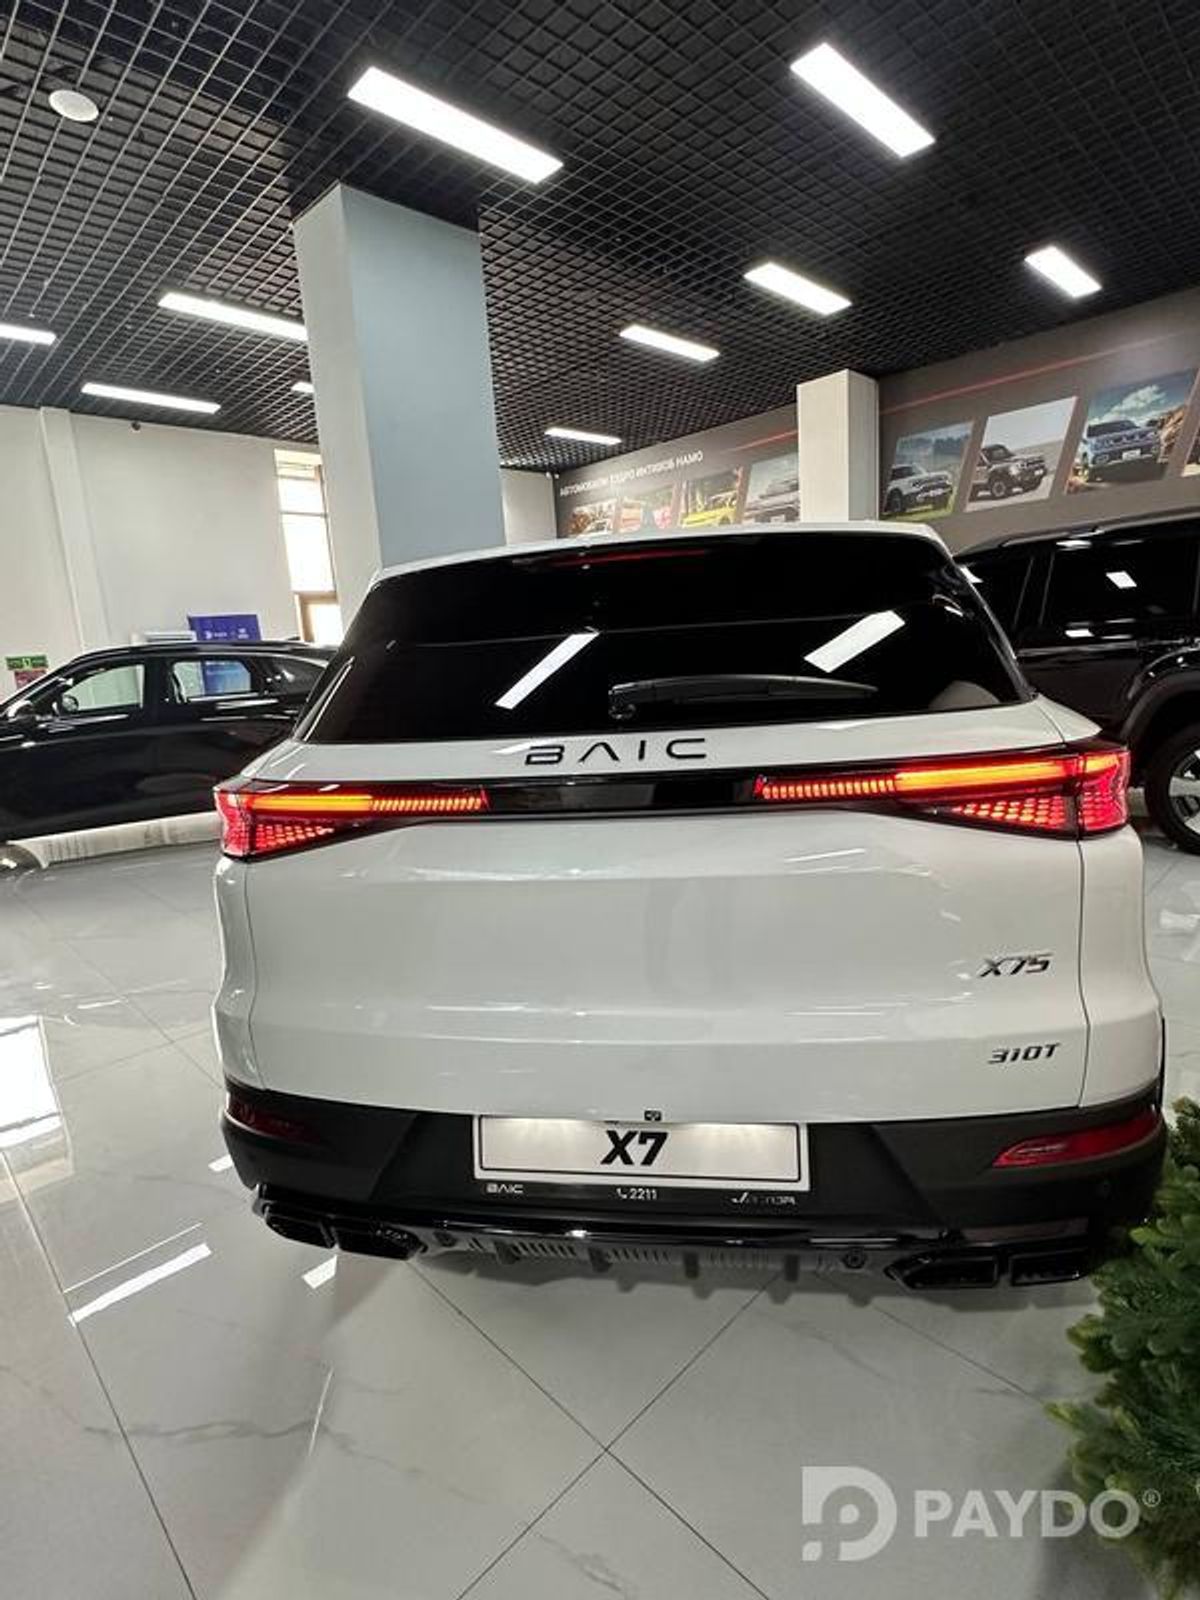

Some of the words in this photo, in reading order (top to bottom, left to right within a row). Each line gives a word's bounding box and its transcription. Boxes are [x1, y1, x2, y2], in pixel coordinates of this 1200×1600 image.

[525, 738, 706, 765] BAIC
[988, 1042, 1061, 1064] 310T
[600, 1129, 669, 1166] X7
[486, 1182, 524, 1195] BAIC
[629, 1187, 658, 1201] 2211
